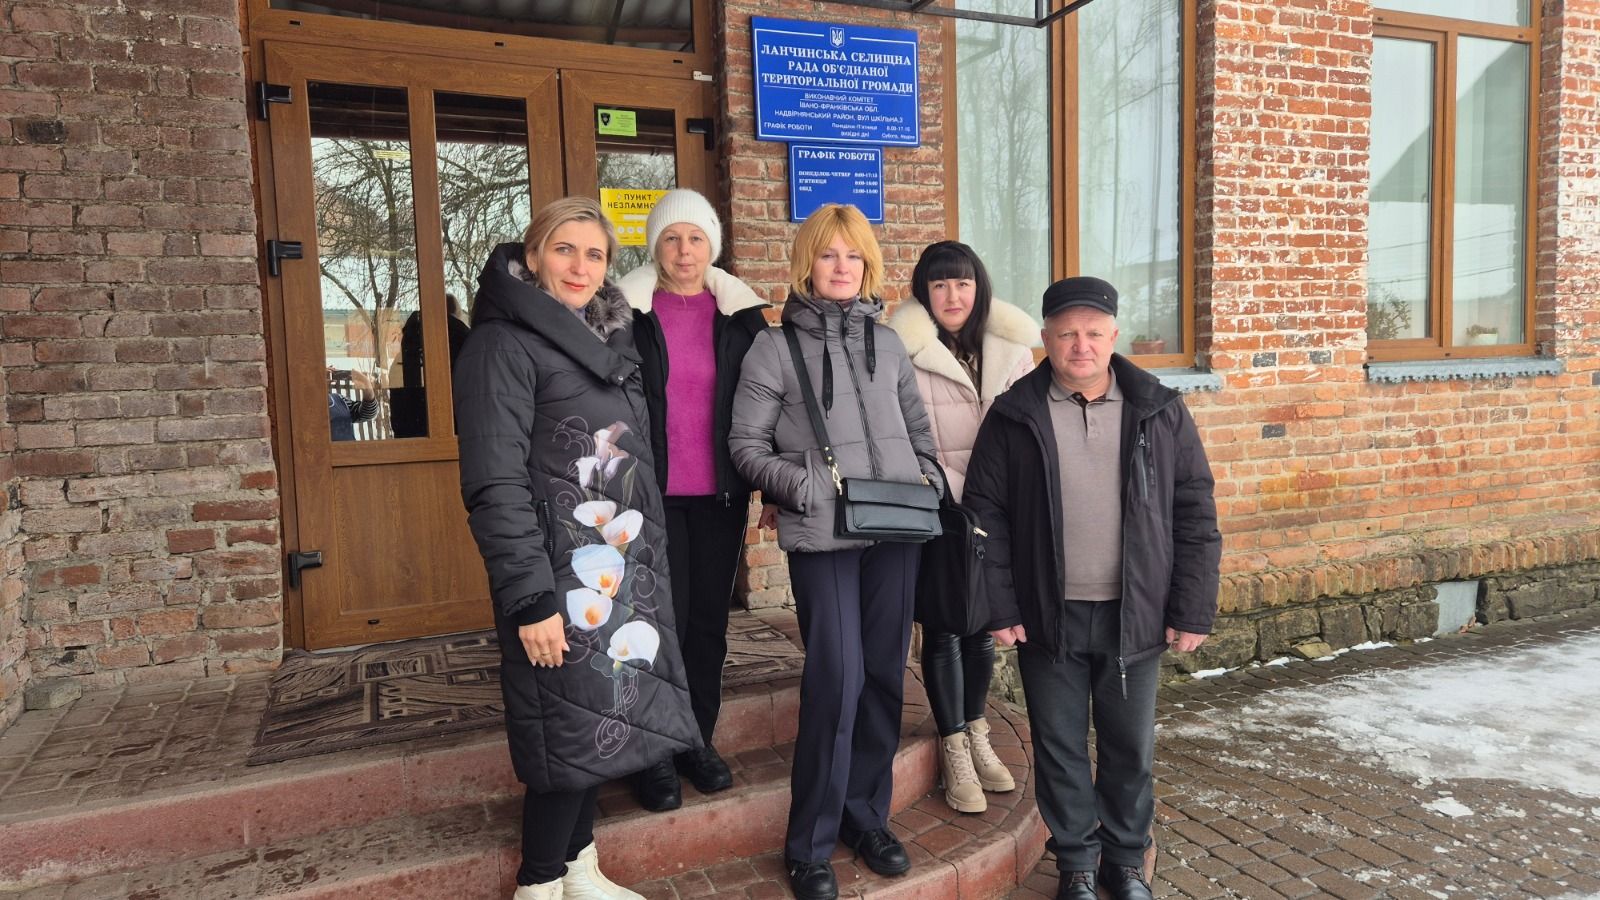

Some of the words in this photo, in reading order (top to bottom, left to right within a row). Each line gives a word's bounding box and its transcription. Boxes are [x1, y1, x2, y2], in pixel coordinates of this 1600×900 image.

[761, 44, 847, 61] ЛАНЧИНСЬКА
[851, 52, 912, 66] СЕЛИЩНА
[788, 60, 819, 73] РАДА
[822, 64, 889, 77] ОБ'ЄДНАНОЇ
[761, 73, 859, 89] ТЕРИТОРІАЛЬНОЇ
[862, 80, 913, 94] ГРОМАДИ
[804, 92, 847, 101] ВИКОНАВЧИЙ
[774, 110, 831, 119] НАДВІРНЯНСЬКИЙ
[798, 150, 835, 160] ГРАФІК
[839, 151, 875, 161] РОБОТИ
[624, 193, 652, 201] ПУНКТ
[607, 201, 656, 209] НЕЗЛАМНО
